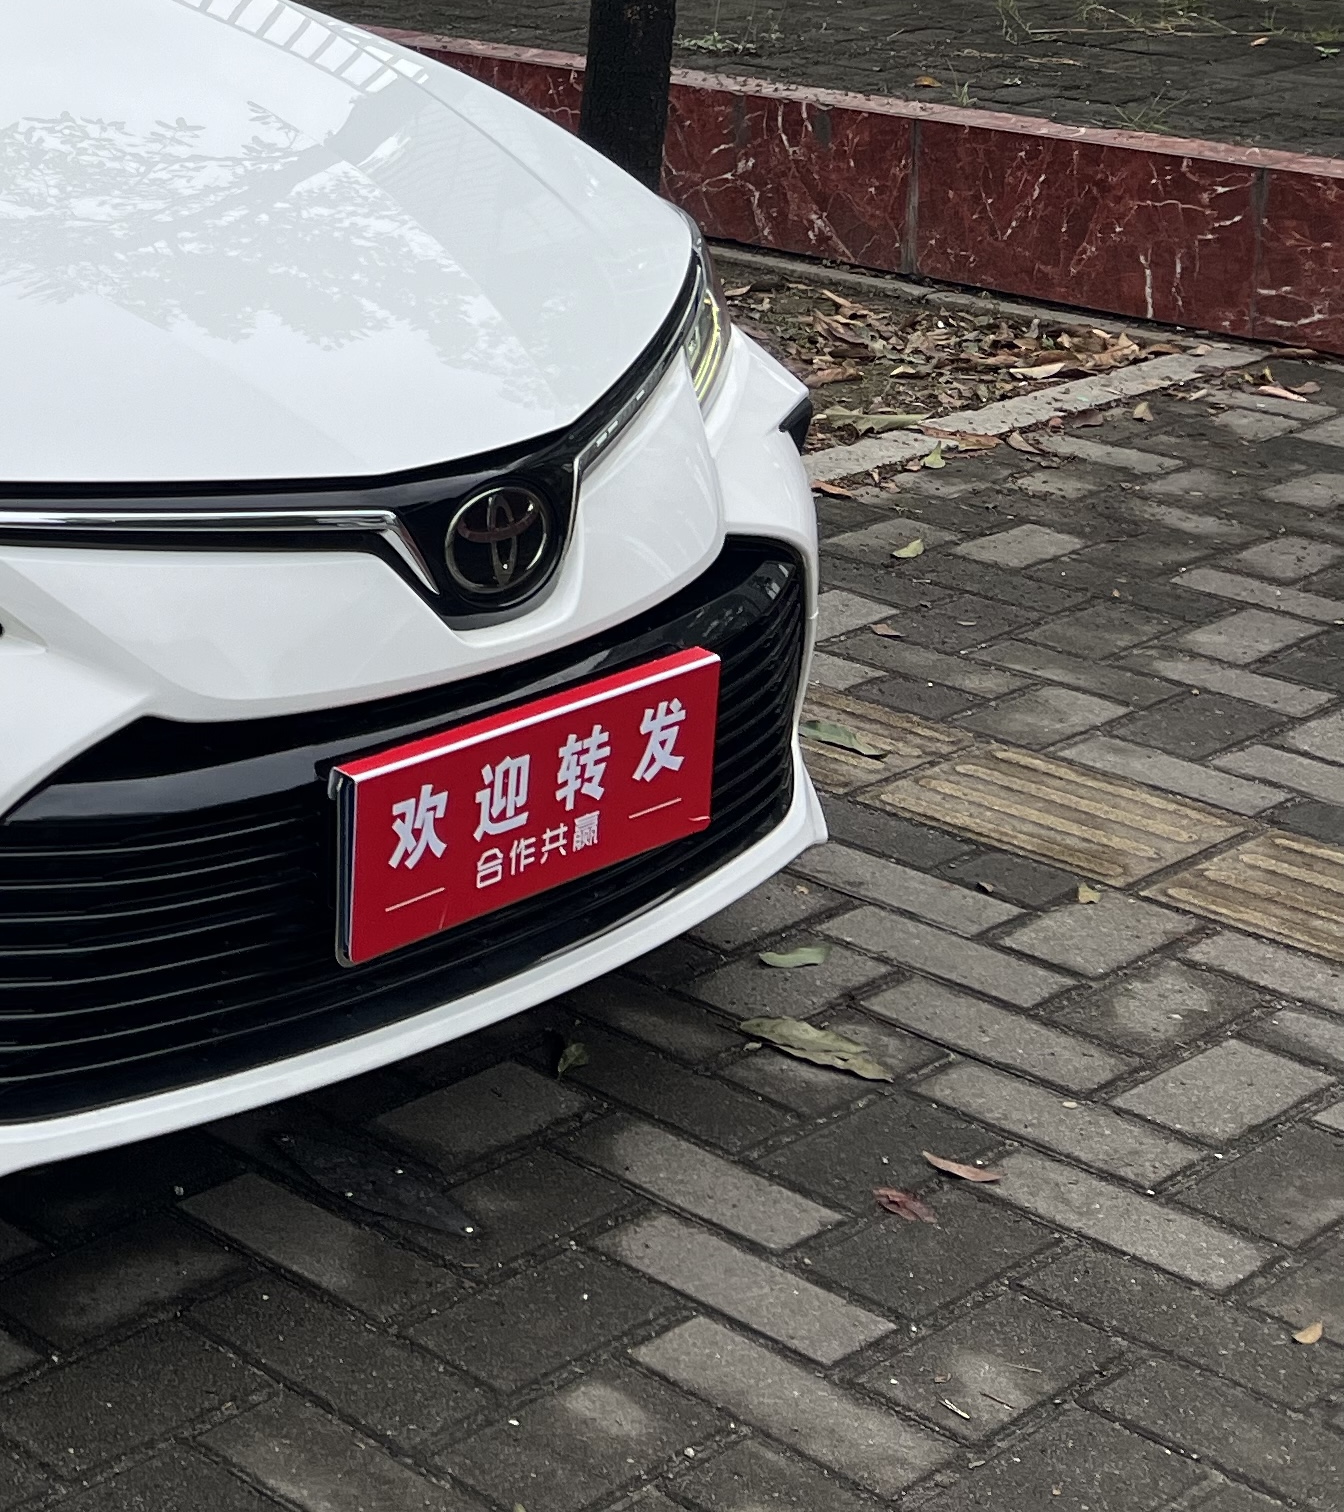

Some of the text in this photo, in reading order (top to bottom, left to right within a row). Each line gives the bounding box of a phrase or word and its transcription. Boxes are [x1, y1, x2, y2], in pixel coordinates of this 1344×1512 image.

[387, 697, 687, 870] 欢迎转发
[475, 810, 600, 890] 合作共赢
